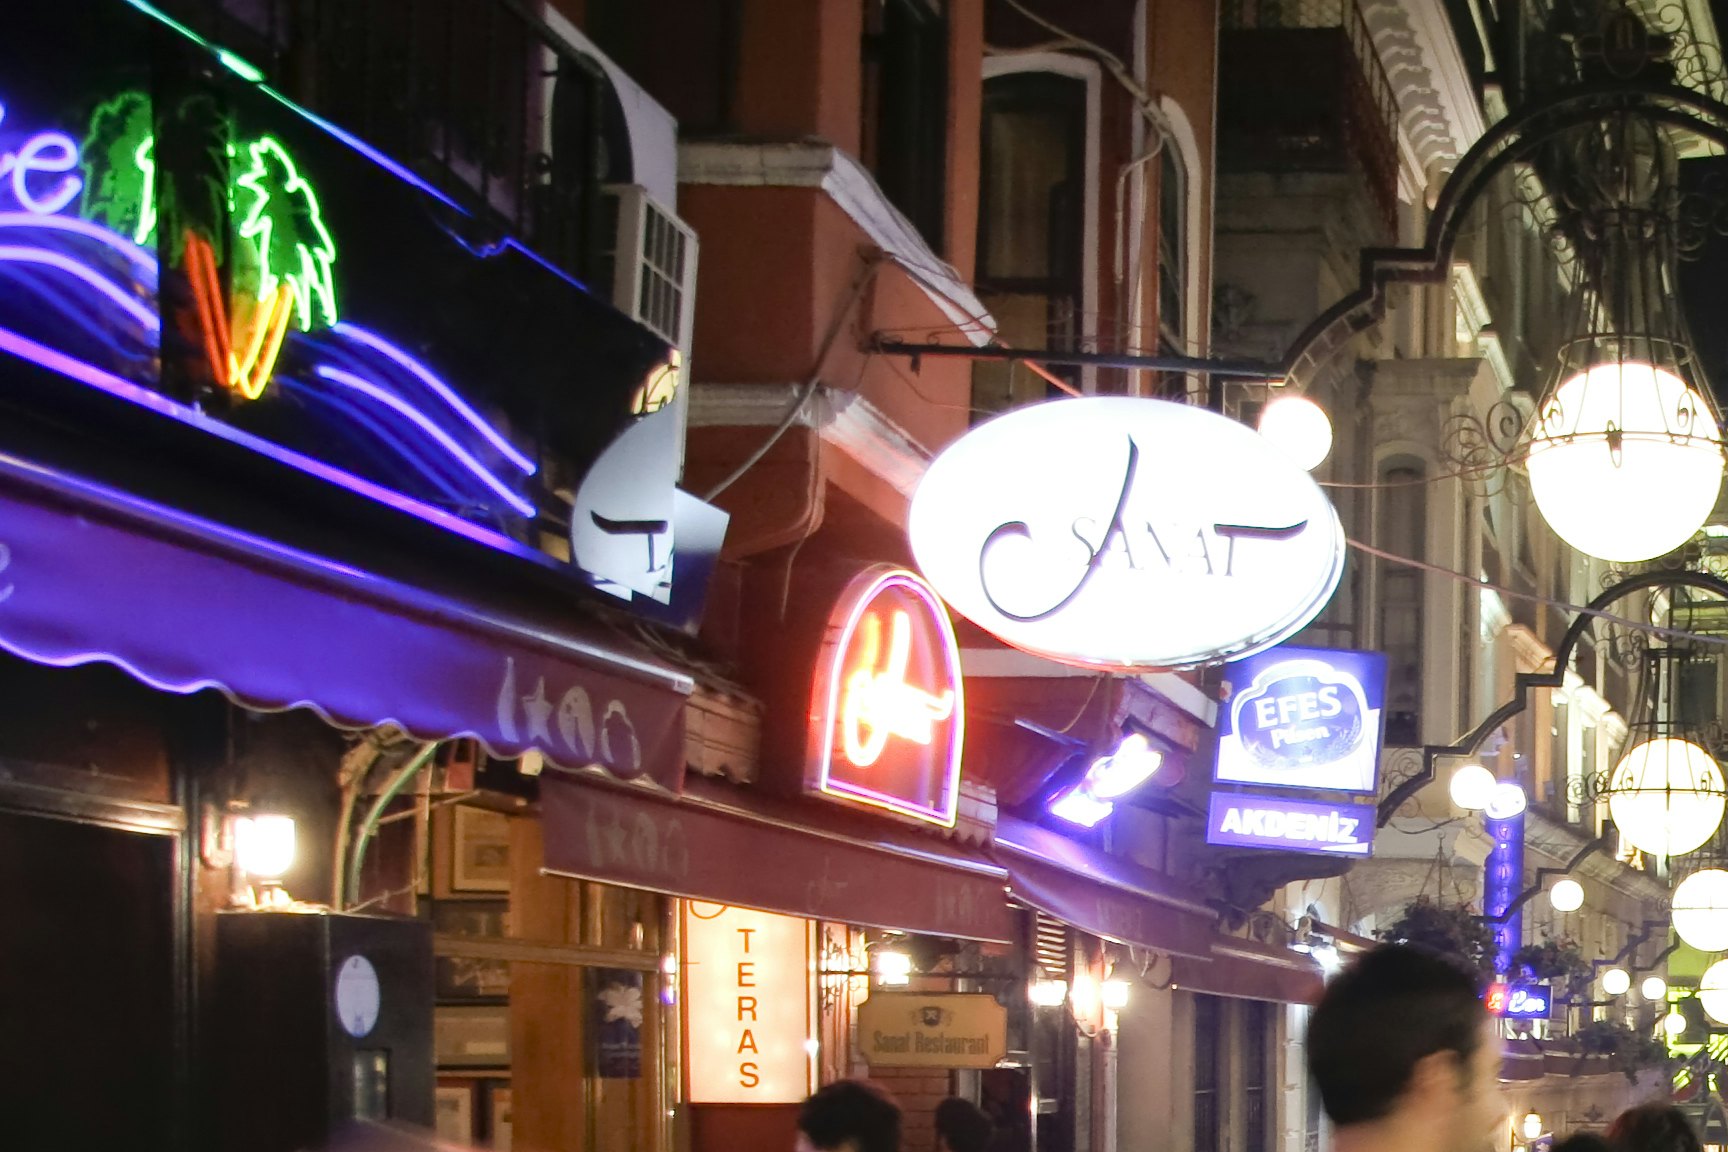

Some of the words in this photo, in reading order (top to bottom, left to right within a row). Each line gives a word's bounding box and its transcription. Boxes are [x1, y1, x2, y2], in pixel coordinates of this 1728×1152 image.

[1255, 686, 1342, 728] EFES
[1271, 725, 1330, 749] Pilsen
[1220, 808, 1359, 843] AKDENİZ
[736, 928, 760, 1089] TERAS
[915, 1031, 989, 1054] Restaurant
